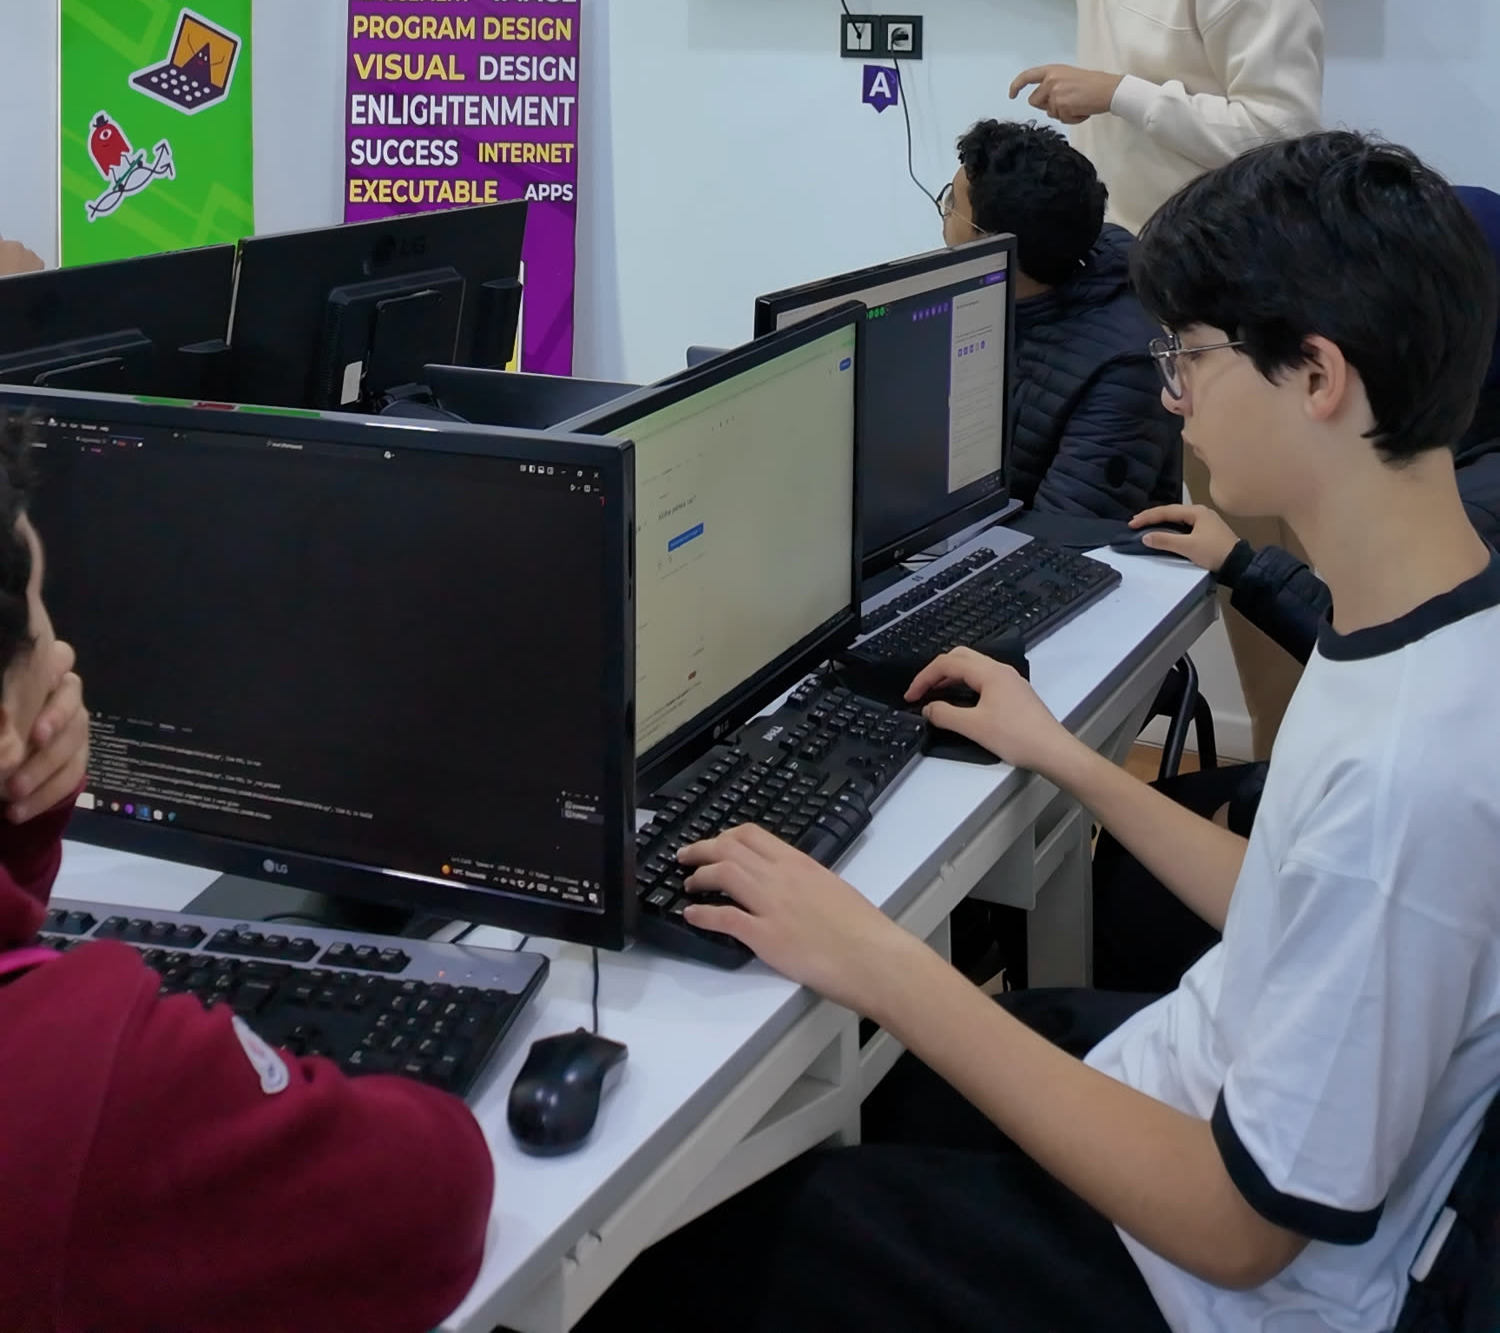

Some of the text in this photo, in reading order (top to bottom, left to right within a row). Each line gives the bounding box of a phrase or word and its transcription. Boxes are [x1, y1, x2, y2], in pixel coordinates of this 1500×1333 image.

[353, 16, 572, 41] PROGRAM DESIGN
[353, 53, 576, 81] VISUAL DESIGN
[868, 71, 892, 99] A
[352, 94, 575, 127] ENLIGHTENMENT
[350, 139, 574, 166] SUCCESS INTERNET
[350, 179, 573, 204] EXECUTABLE APPS
[762, 725, 784, 741] DELL
[275, 862, 289, 875] LG
